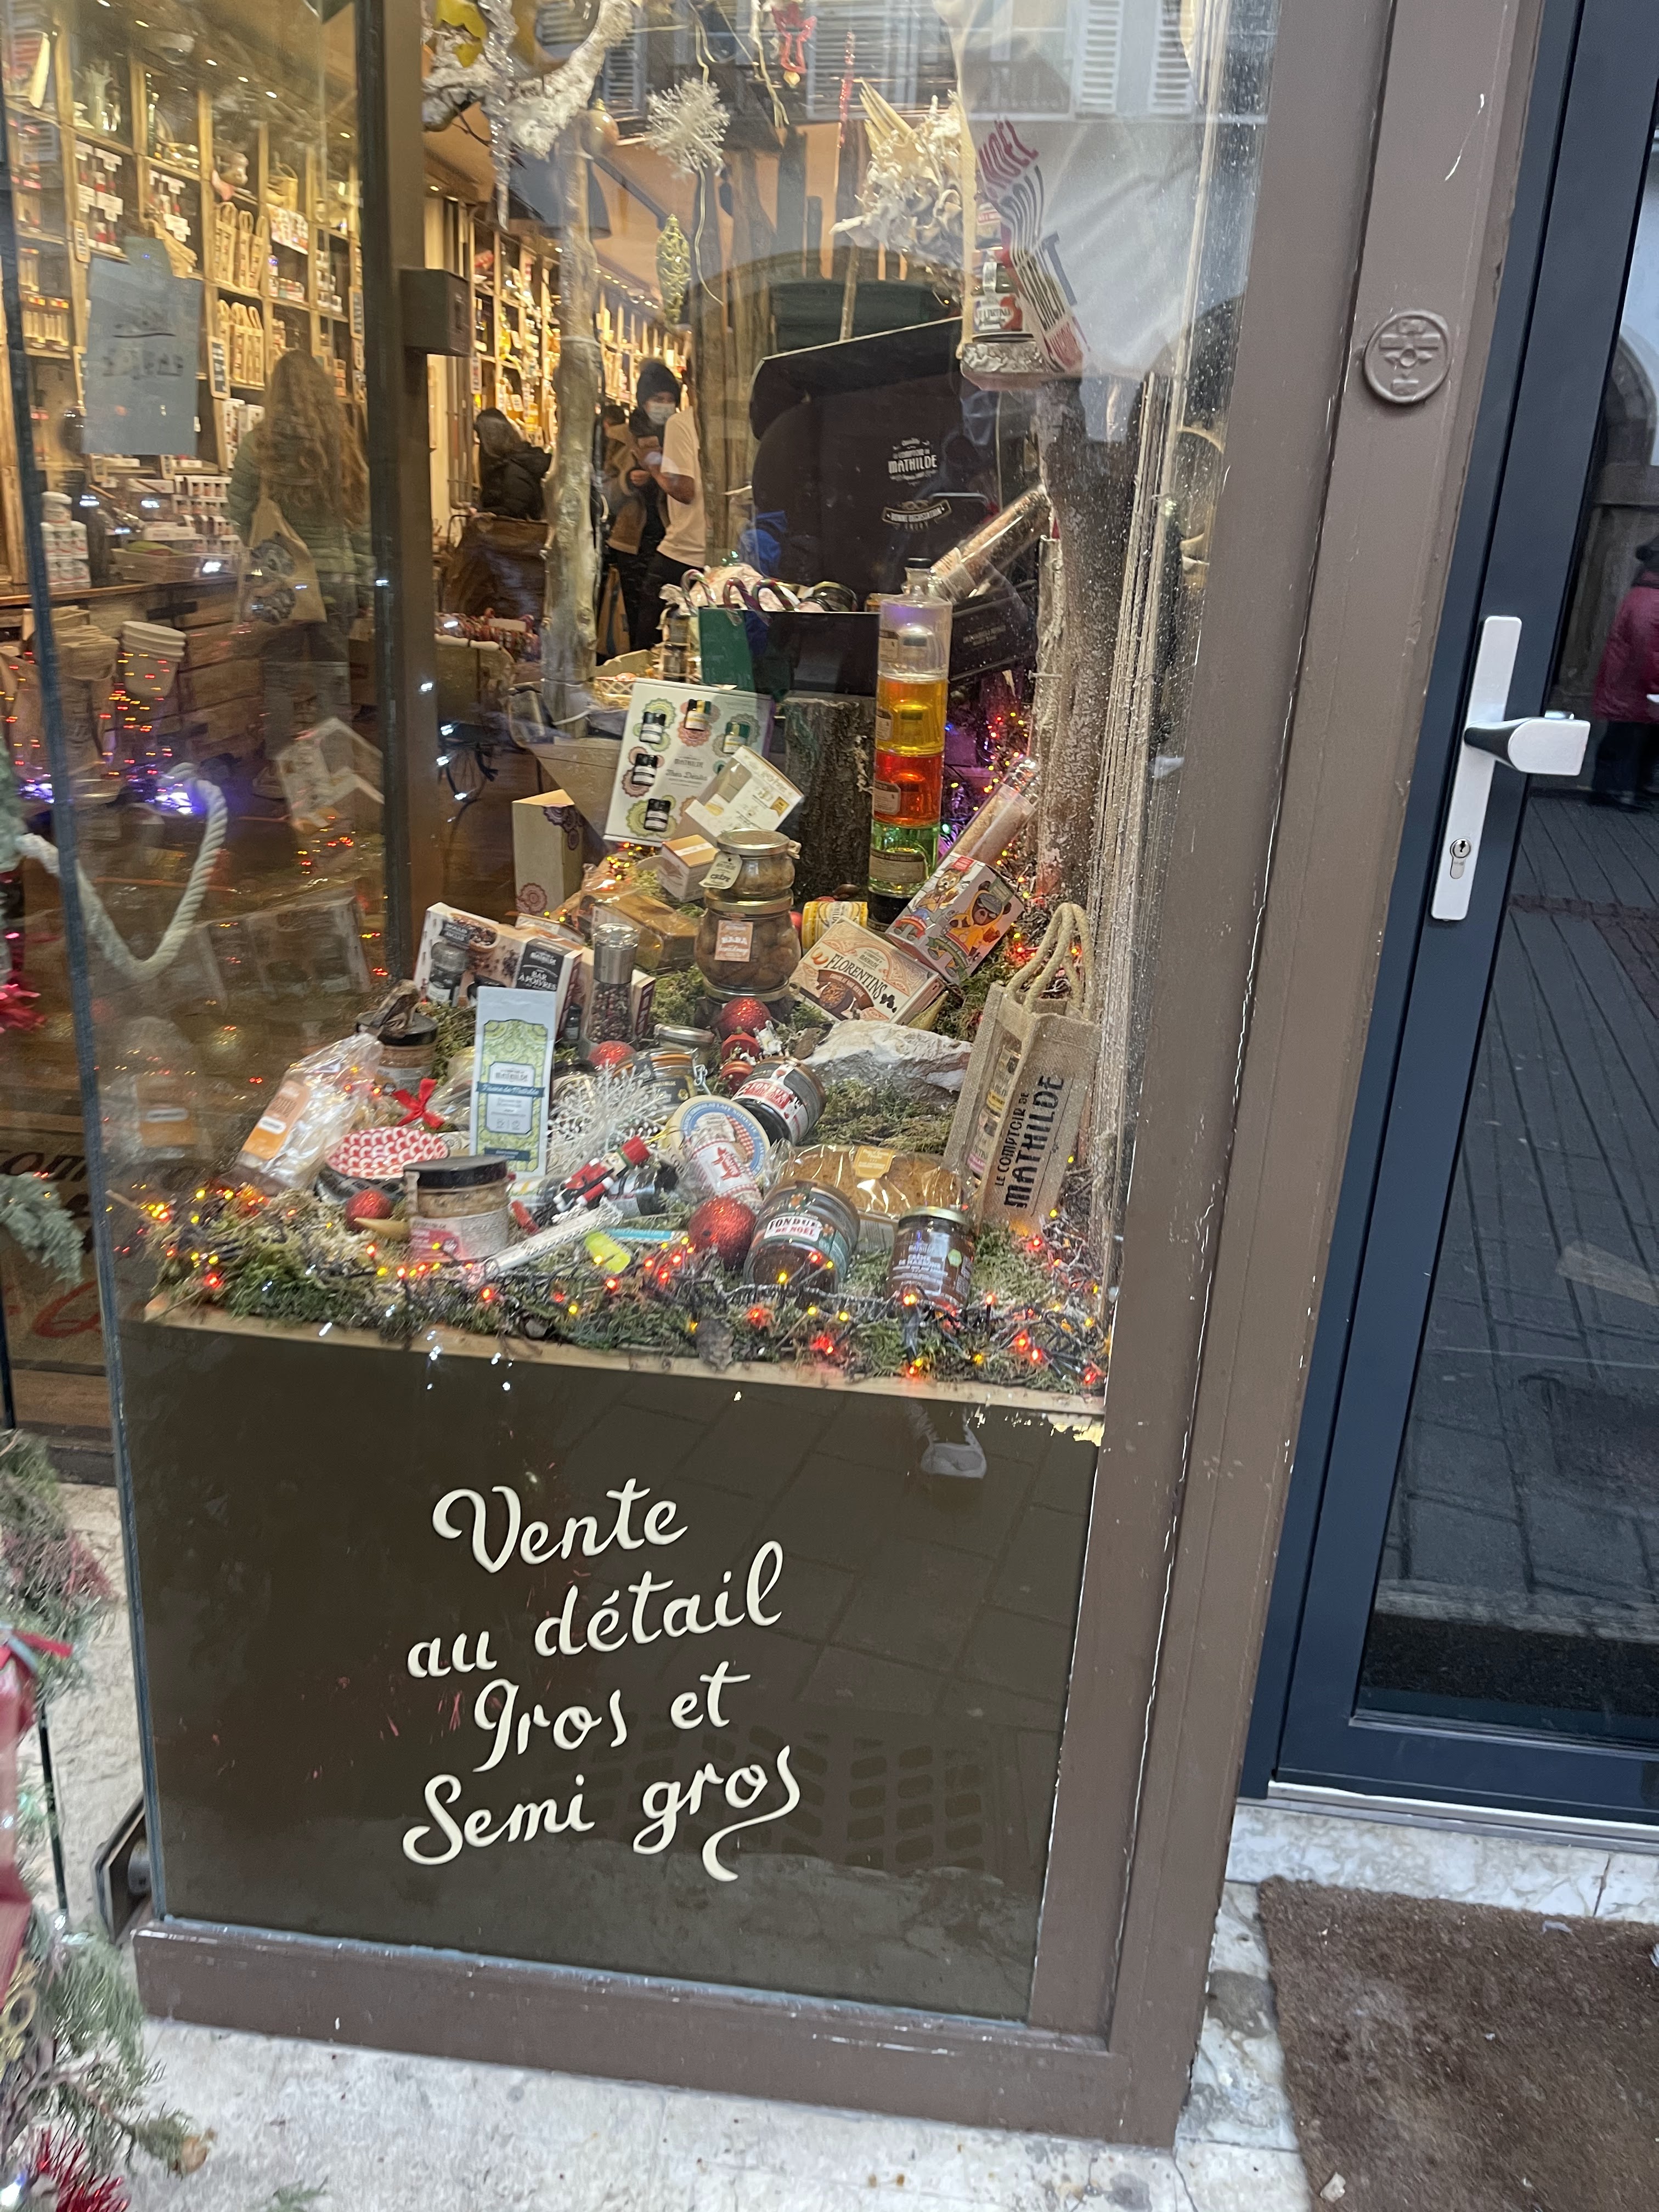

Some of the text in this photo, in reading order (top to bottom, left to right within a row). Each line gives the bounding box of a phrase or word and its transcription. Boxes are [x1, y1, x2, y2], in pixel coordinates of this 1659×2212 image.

[888, 455, 938, 473] MATHILDE
[525, 975, 557, 990] POIVRES
[532, 970, 547, 980] BAR
[823, 953, 888, 1000] FLORENTINS
[1019, 1092, 1029, 1104] DE
[997, 1108, 1026, 1173] COMPTOIR
[1004, 1075, 1064, 1208] MATHILDE
[995, 1175, 1005, 1186] LE
[432, 1478, 688, 1573] Vente
[408, 1540, 783, 1678] au détail
[670, 1661, 751, 1729] et
[403, 1745, 800, 1882] Semi gros
